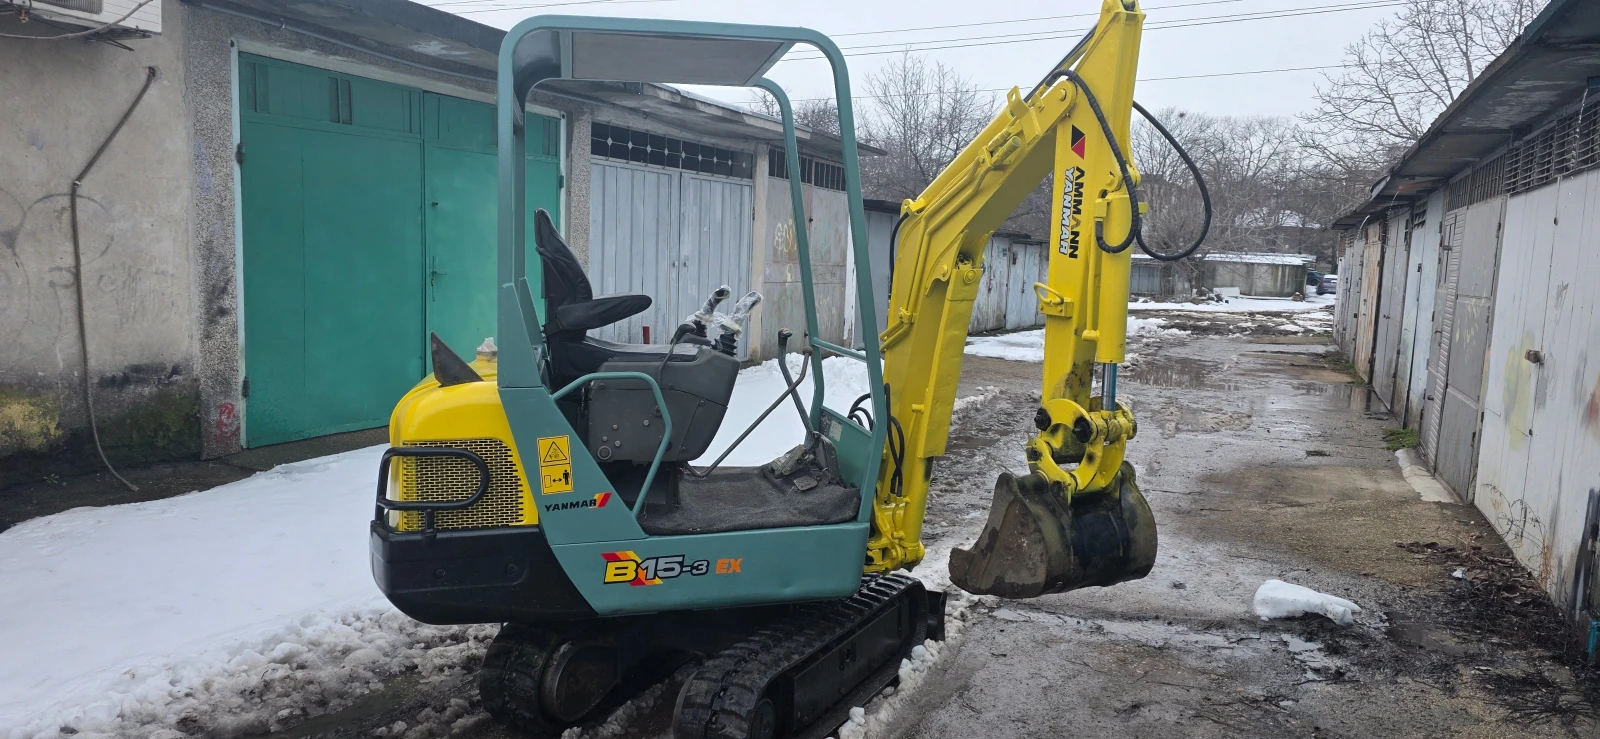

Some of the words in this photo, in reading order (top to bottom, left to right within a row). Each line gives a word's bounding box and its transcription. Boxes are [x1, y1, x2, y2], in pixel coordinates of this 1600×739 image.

[1059, 167, 1075, 255] YANMAR
[1069, 166, 1085, 259] AMMANN
[544, 498, 597, 512] YANMAR
[603, 554, 709, 584] B15-3
[715, 557, 743, 574] EX
